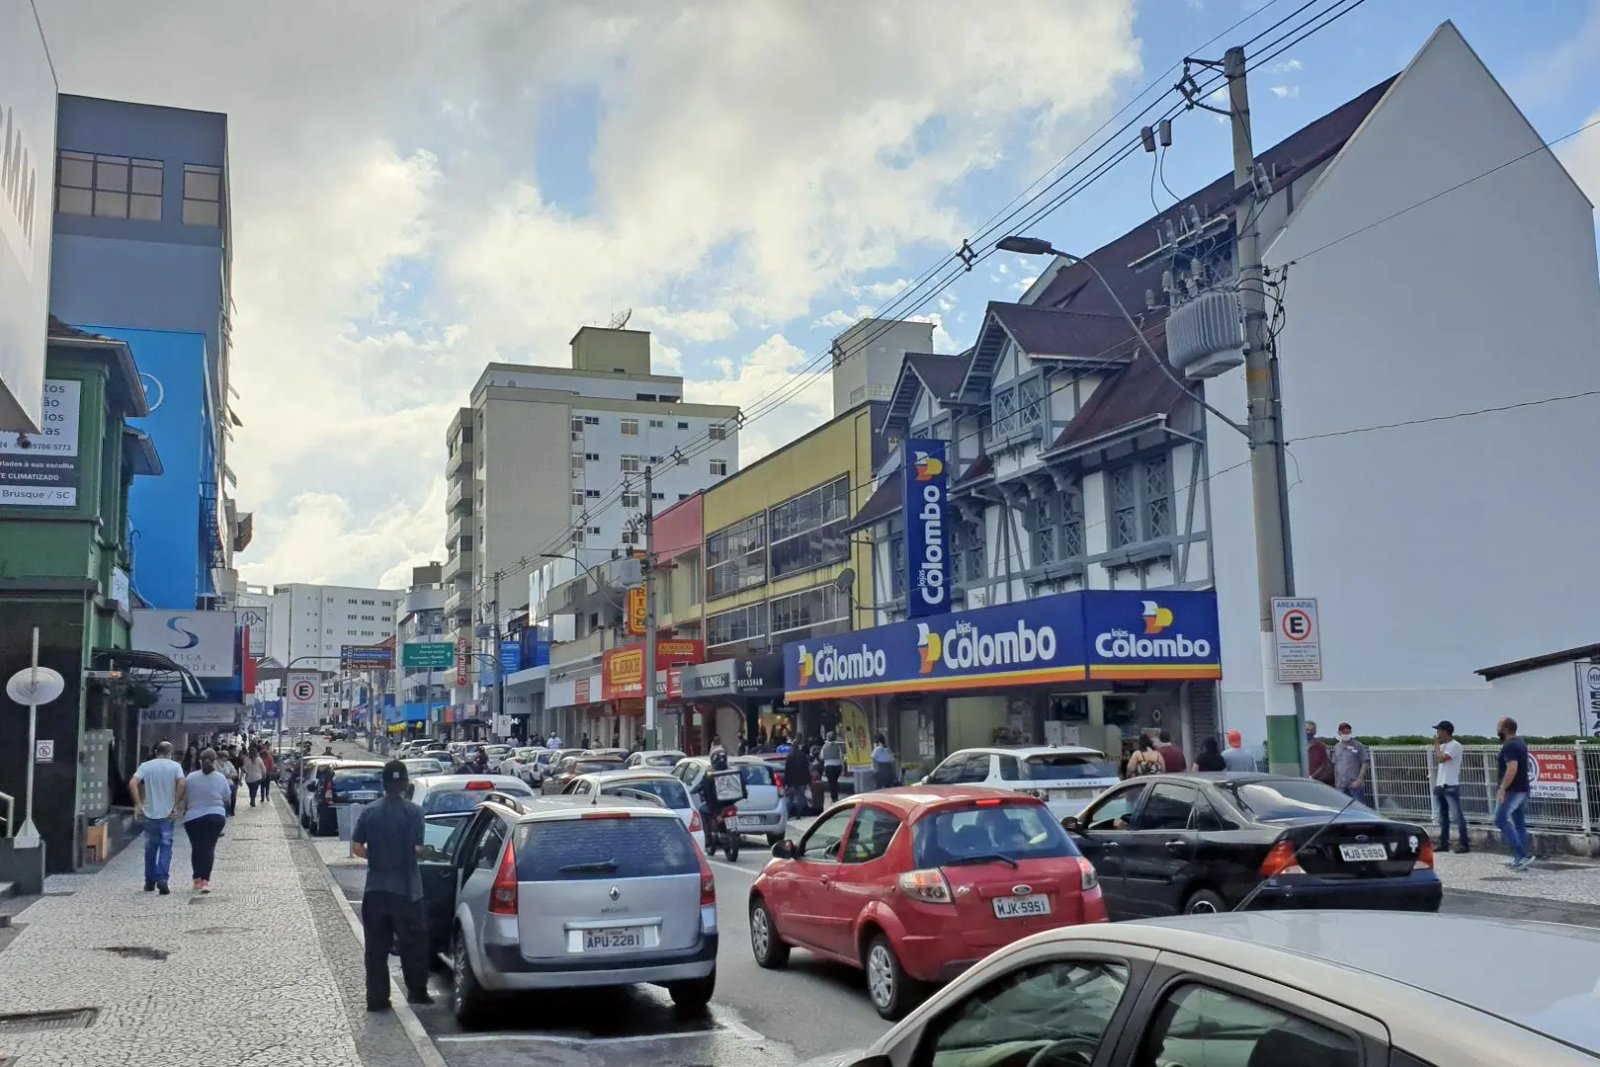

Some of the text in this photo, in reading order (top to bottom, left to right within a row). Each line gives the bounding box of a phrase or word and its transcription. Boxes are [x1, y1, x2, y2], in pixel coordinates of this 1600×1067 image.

[44, 383, 65, 393] tos
[44, 397, 60, 408] ão
[44, 411, 64, 422] ios
[8, 472, 60, 481] CLIMATIZADO
[2, 489, 45, 500] Brusque
[56, 491, 71, 500] SC
[919, 484, 944, 605] Colombo
[916, 569, 926, 588] lojas
[955, 620, 973, 635] lojas
[1289, 616, 1304, 634] E
[1111, 628, 1129, 639] lojas
[823, 643, 834, 656] lojas
[943, 619, 1057, 670] Colombo
[1095, 632, 1211, 658] Colombo
[814, 643, 886, 683] Colombo
[299, 685, 309, 696] E
